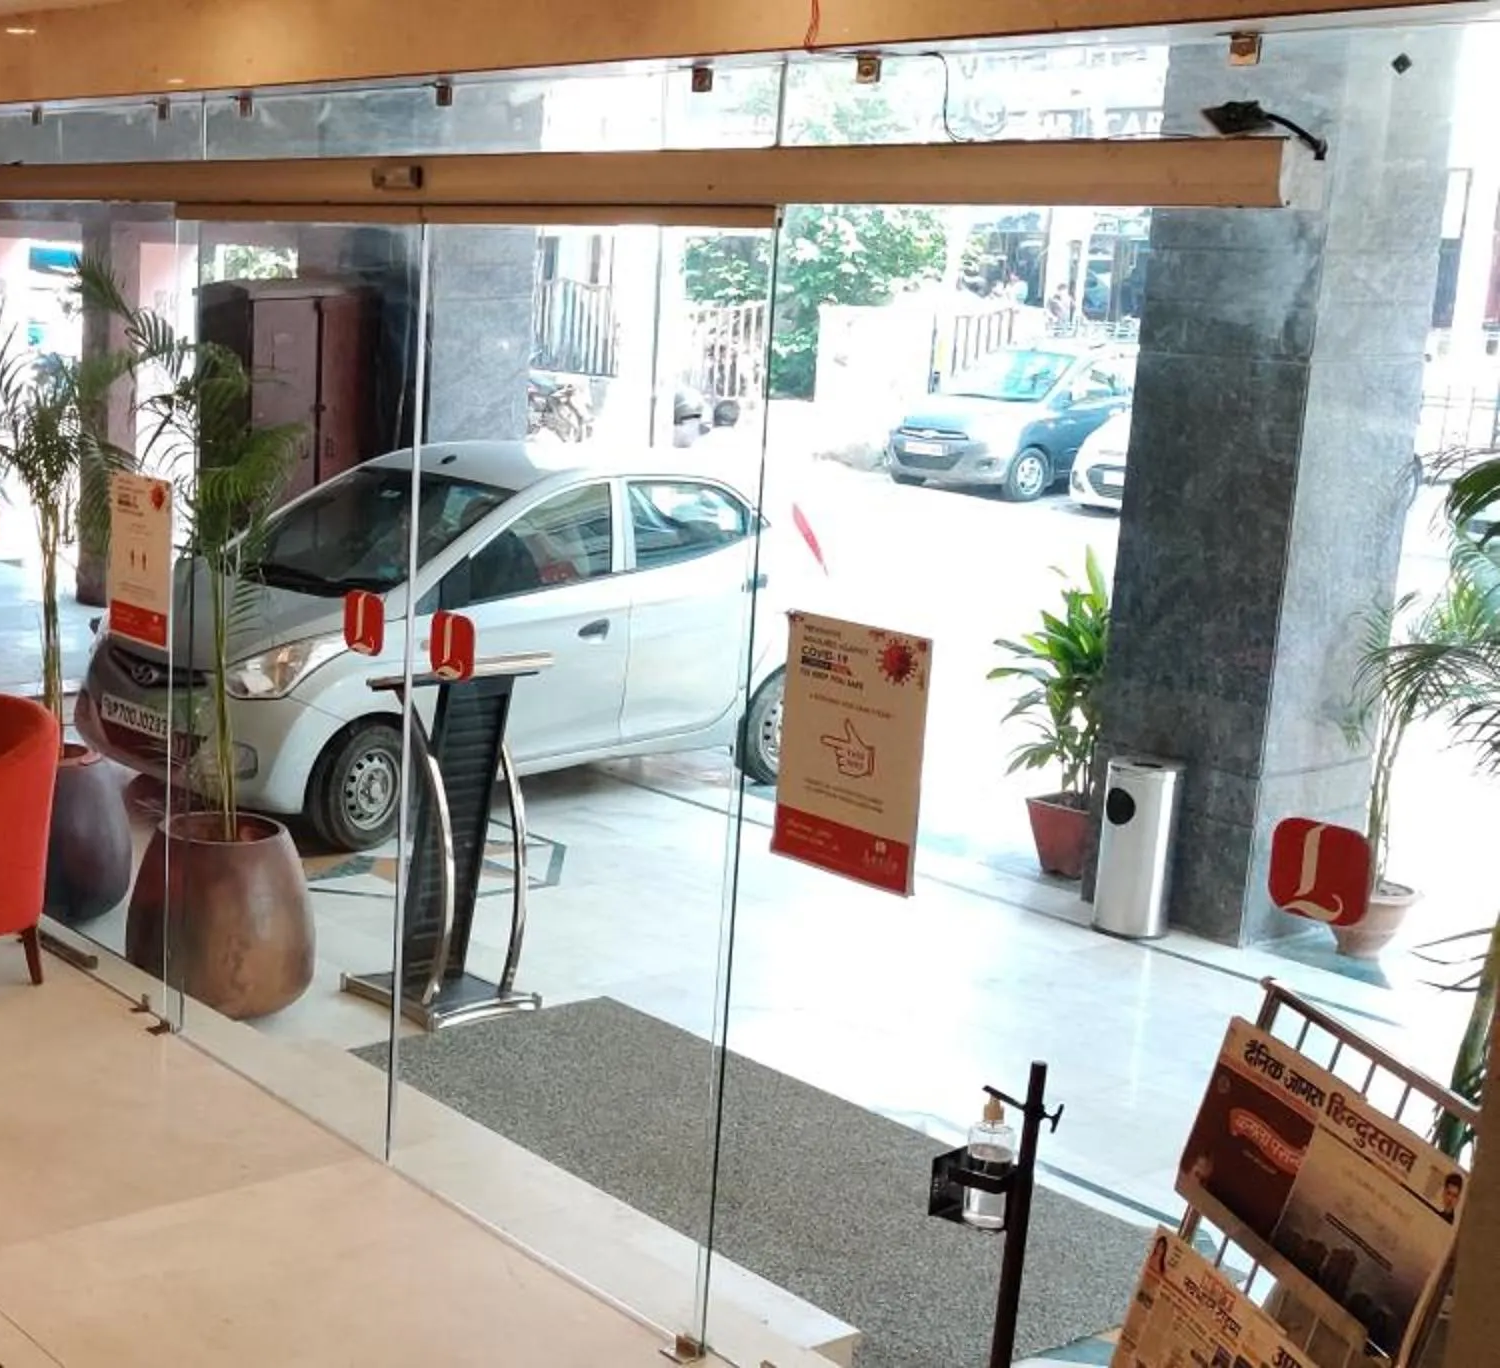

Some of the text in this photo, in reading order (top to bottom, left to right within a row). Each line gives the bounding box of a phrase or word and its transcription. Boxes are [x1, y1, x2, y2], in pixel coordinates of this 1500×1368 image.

[1282, 823, 1343, 921] L
[1244, 1039, 1287, 1081] दैनिक
[1326, 1091, 1418, 1173] हिन्दुस्तान
